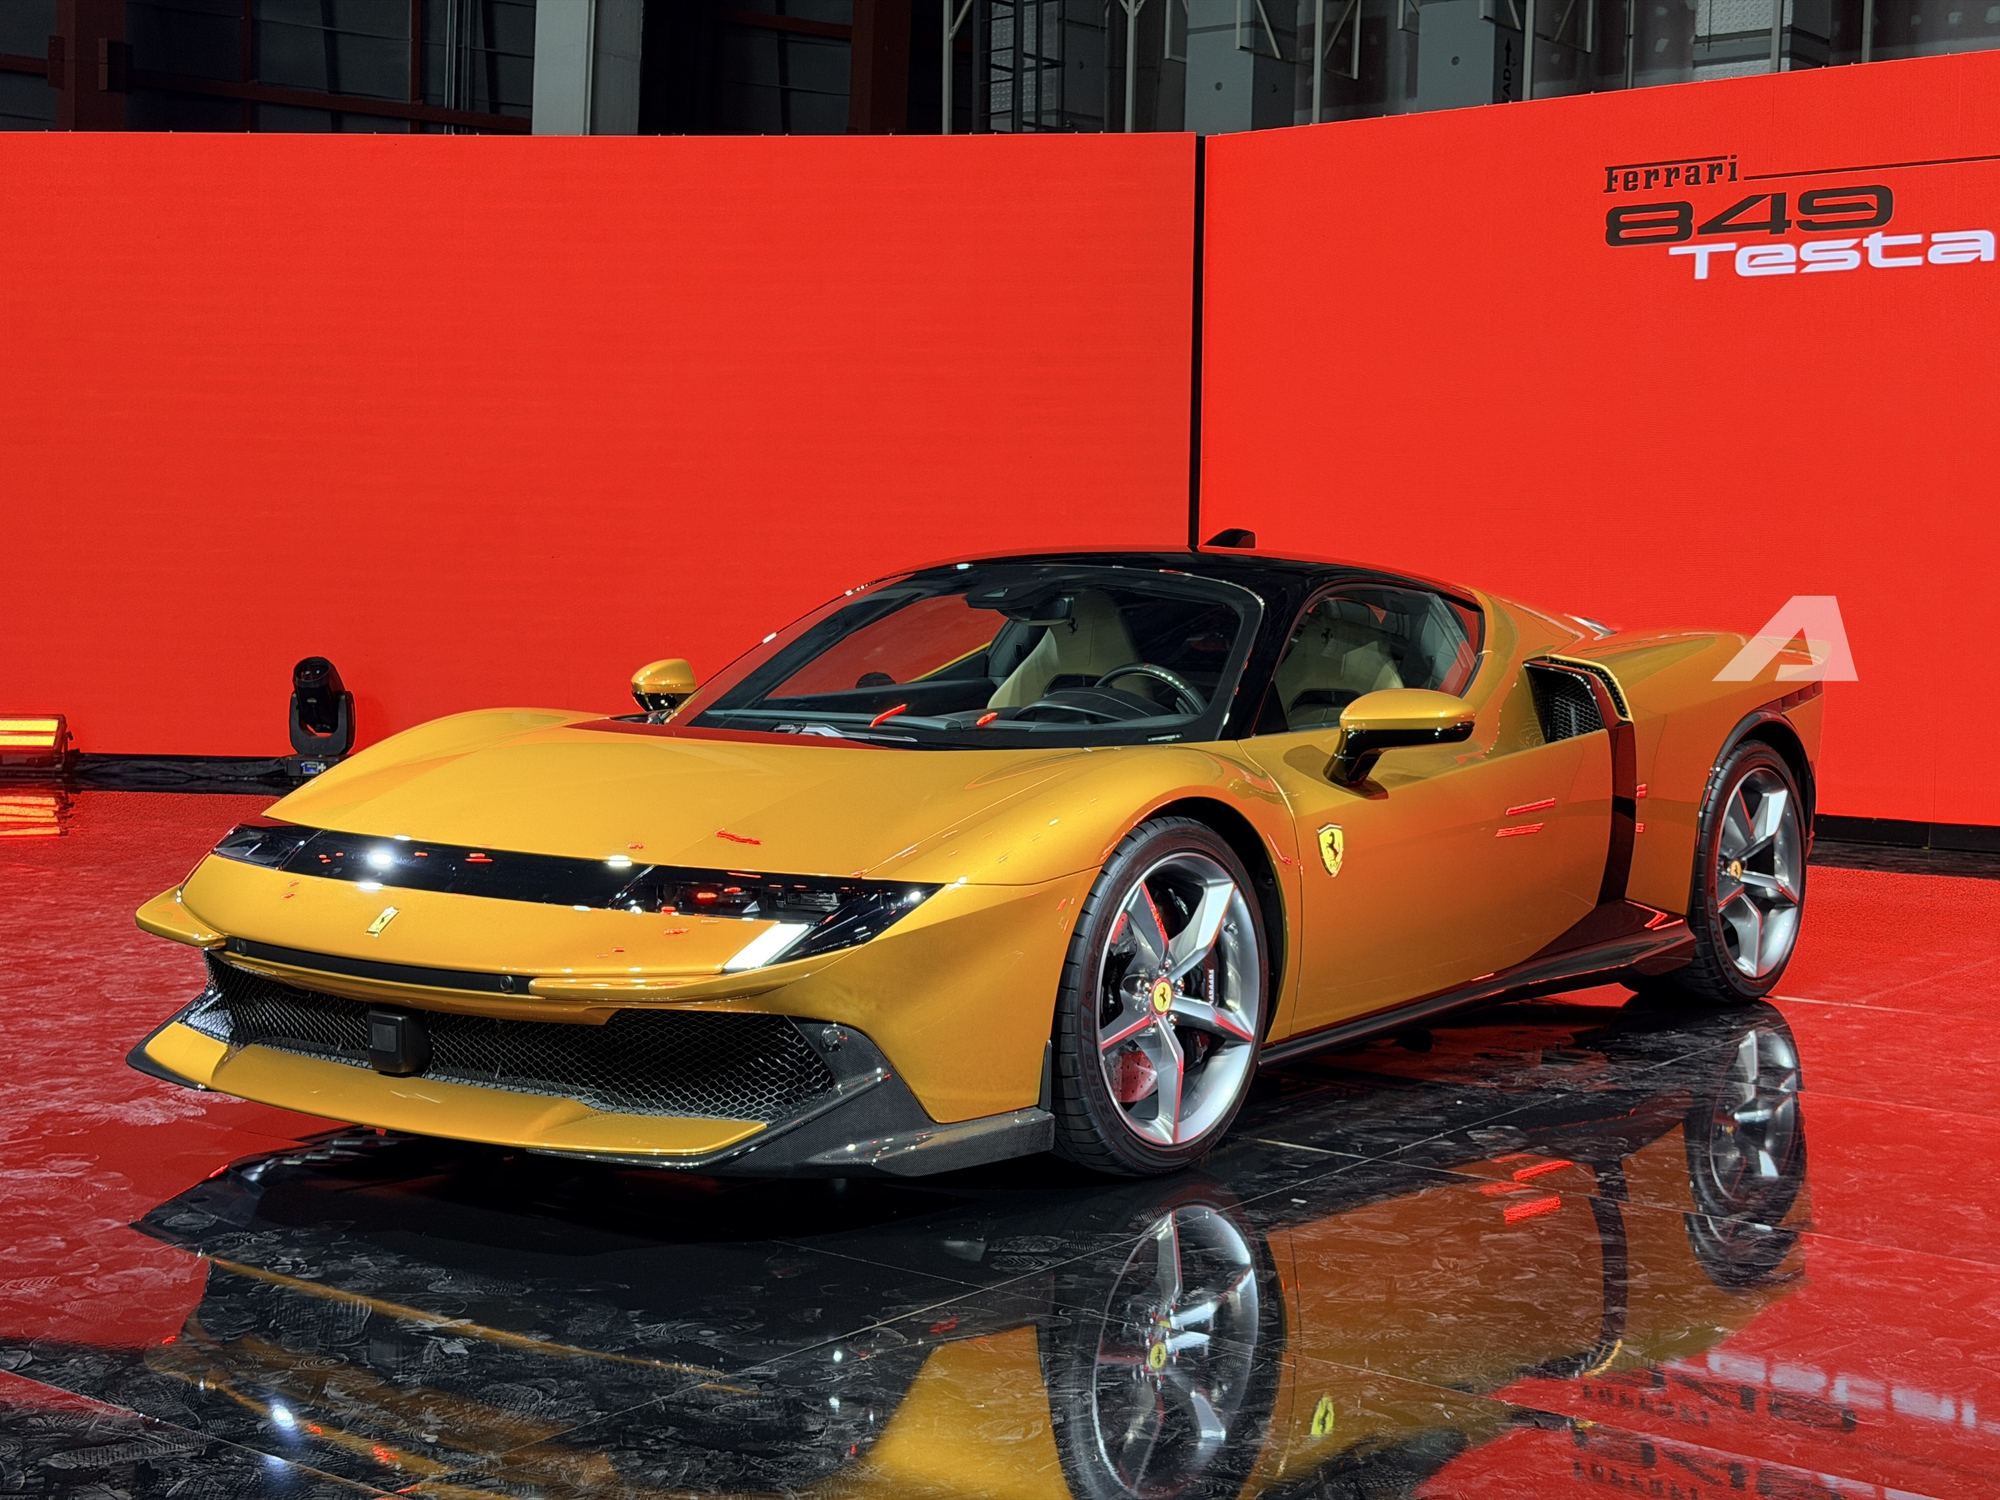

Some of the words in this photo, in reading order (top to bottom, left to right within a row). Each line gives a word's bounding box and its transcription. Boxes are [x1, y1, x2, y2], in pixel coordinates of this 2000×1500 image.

[1604, 155, 1737, 193] Ferrari
[1606, 184, 1894, 247] 849
[1669, 230, 1995, 280] Testa
